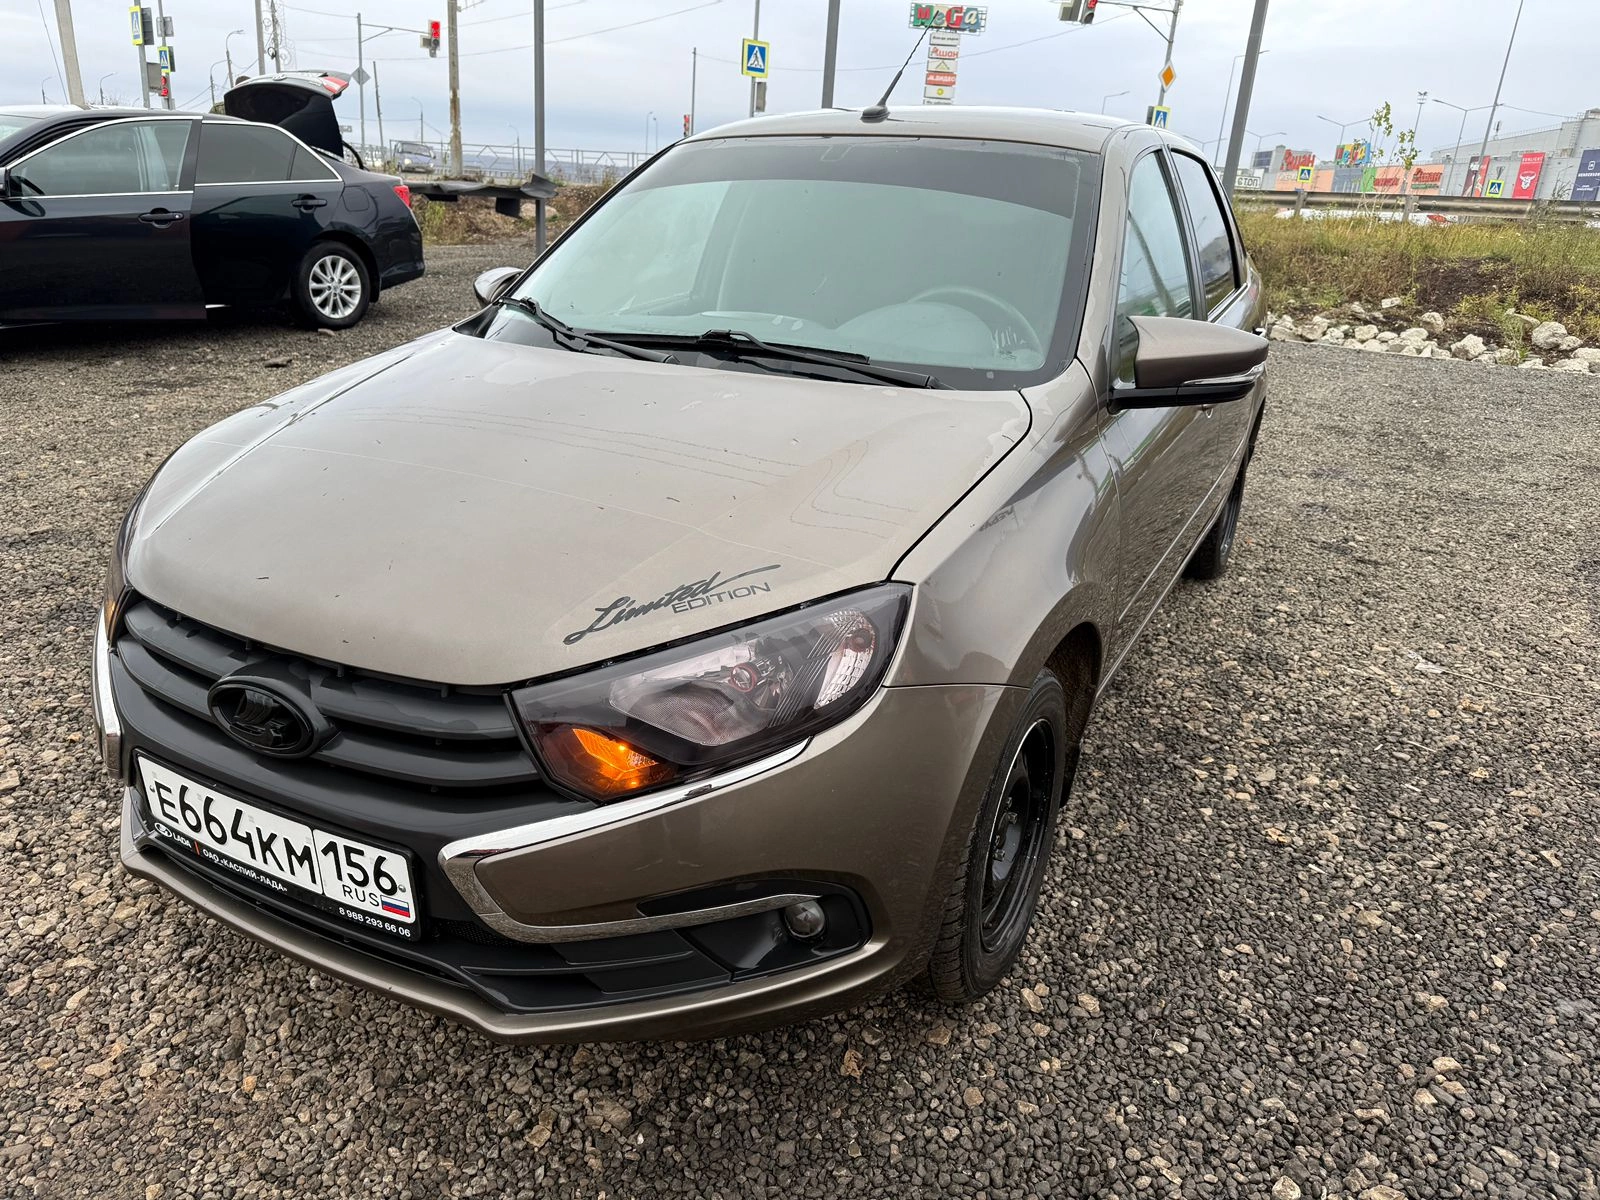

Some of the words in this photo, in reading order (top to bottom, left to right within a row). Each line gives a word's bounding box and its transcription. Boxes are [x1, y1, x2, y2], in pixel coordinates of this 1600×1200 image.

[562, 564, 782, 646] Limited
[671, 581, 771, 614] EDITION
[172, 832, 192, 849] LADA
[320, 840, 398, 897] 156
[342, 884, 380, 907] RUS
[338, 907, 346, 916] 8
[346, 909, 365, 923] 988
[365, 916, 384, 929] 293
[384, 923, 397, 933] 66
[398, 927, 411, 938] 06
